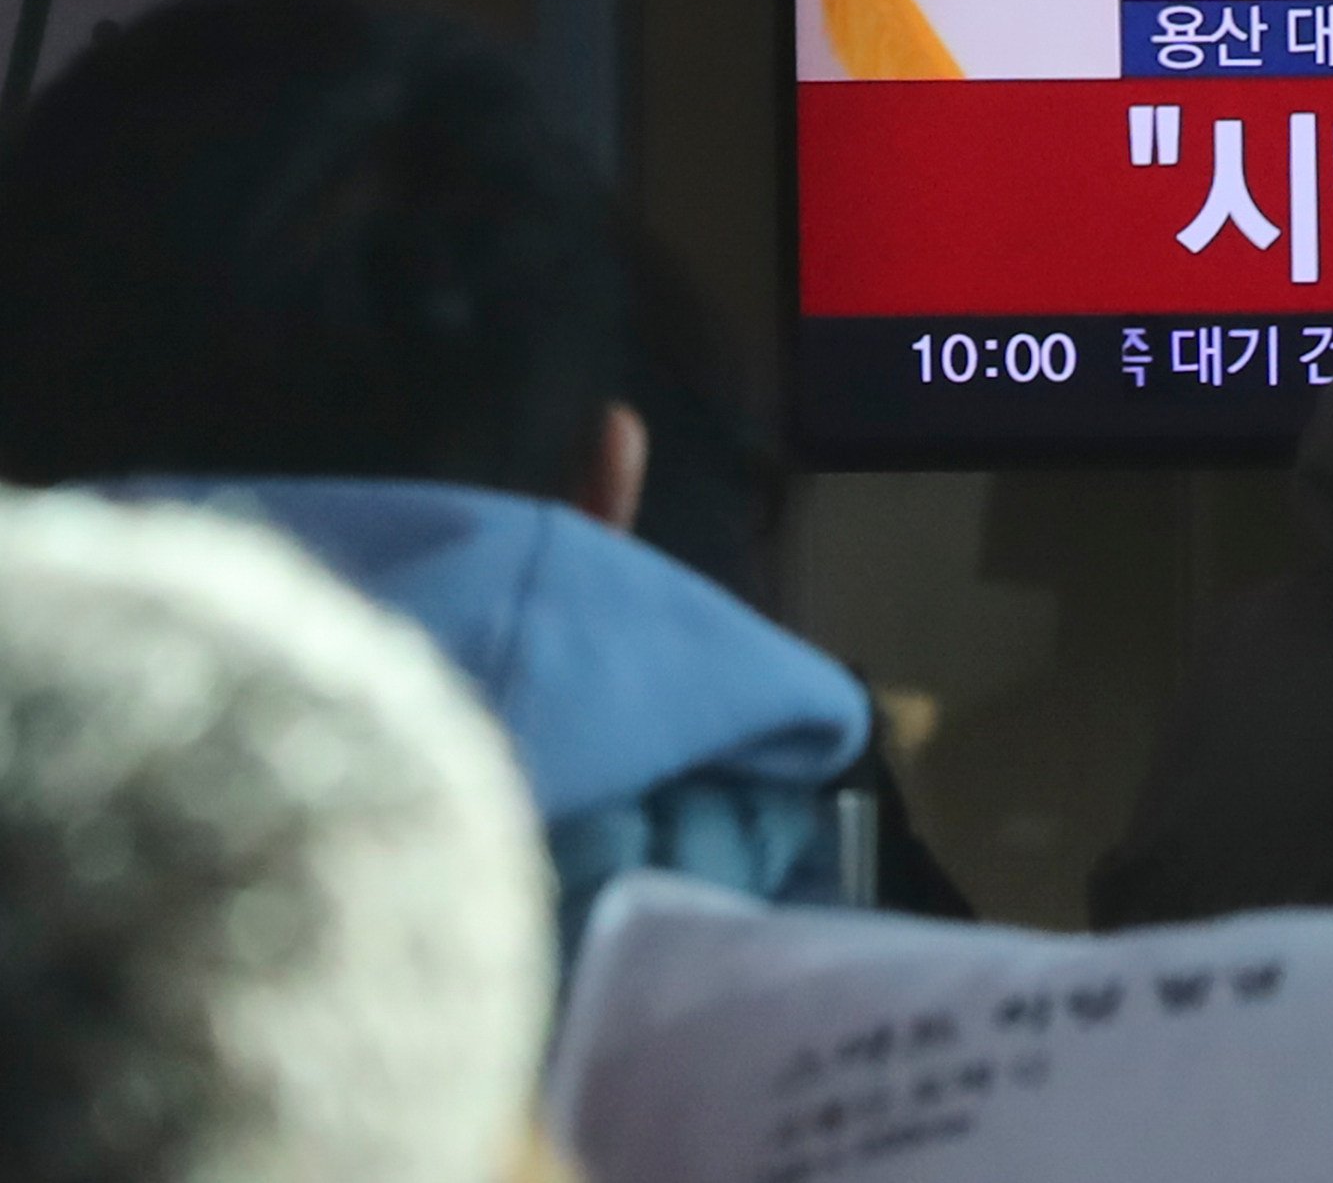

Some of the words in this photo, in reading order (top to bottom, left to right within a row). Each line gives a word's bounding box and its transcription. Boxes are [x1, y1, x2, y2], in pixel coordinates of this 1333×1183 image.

[1151, 5, 1268, 69] 용산
[912, 333, 1077, 383] 10:00
[1171, 326, 1279, 387] 대기
